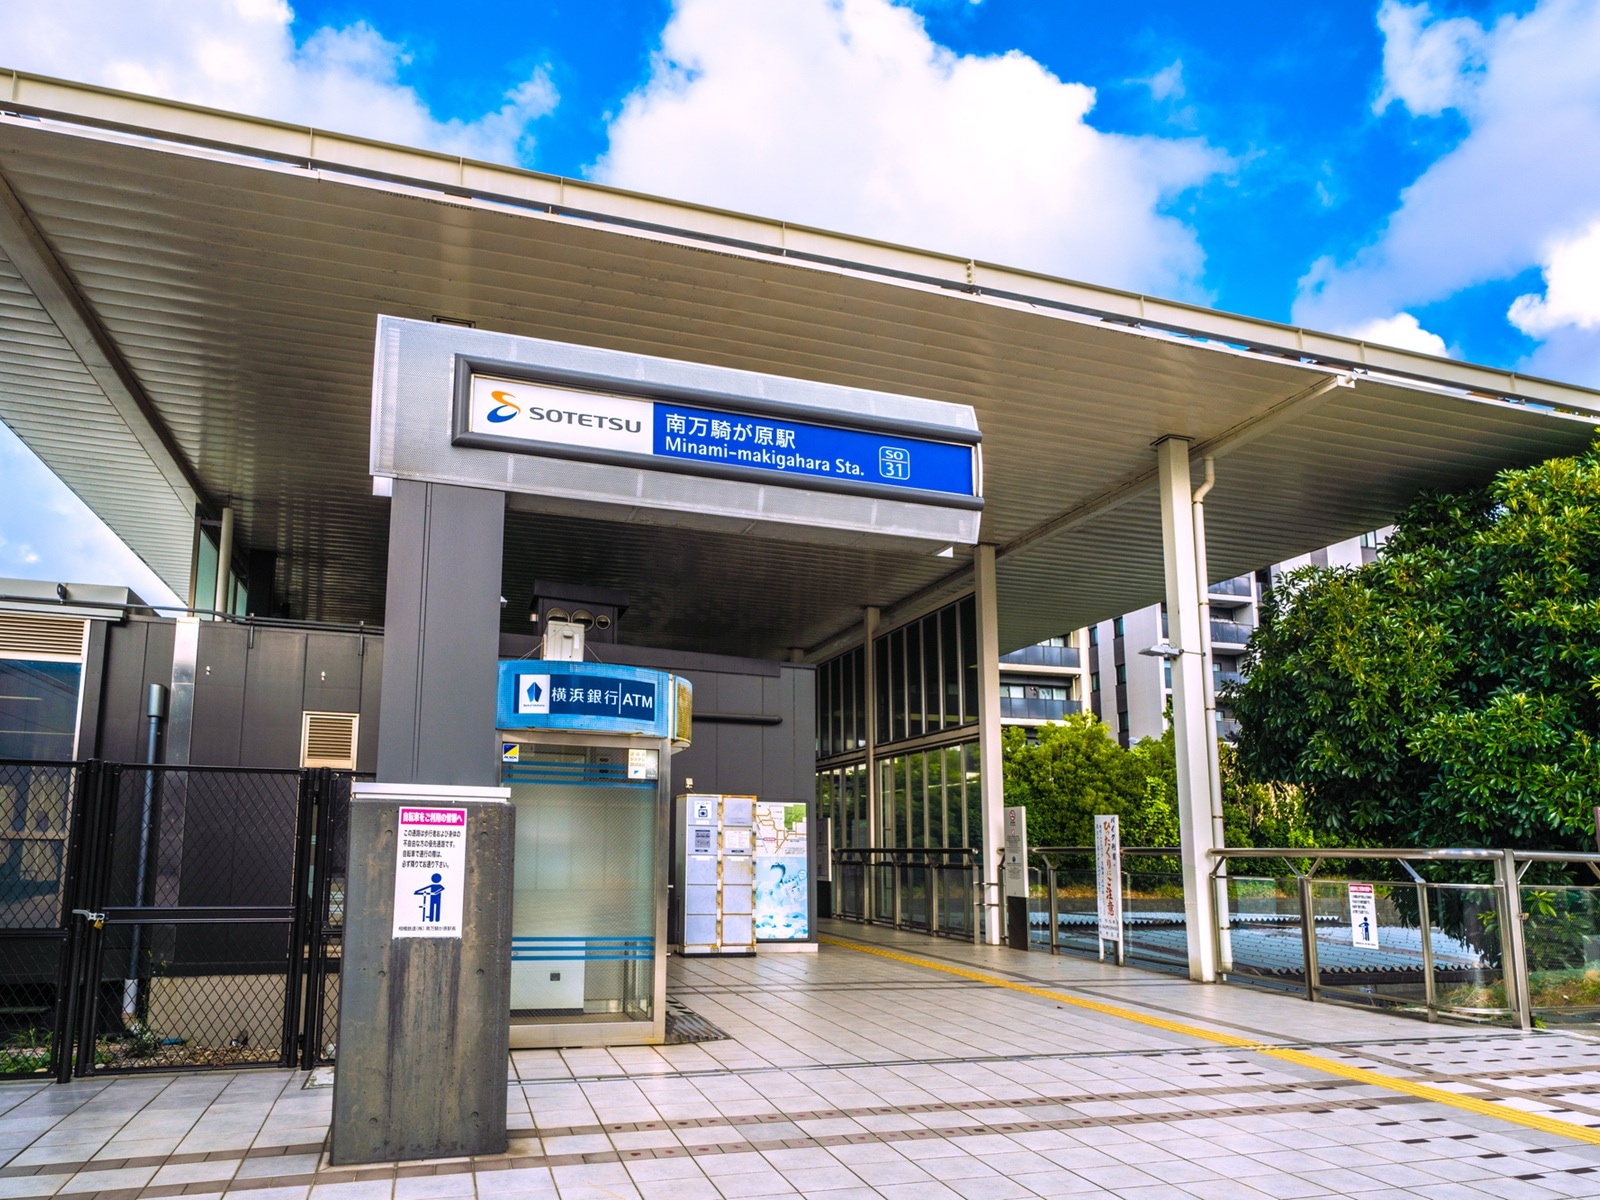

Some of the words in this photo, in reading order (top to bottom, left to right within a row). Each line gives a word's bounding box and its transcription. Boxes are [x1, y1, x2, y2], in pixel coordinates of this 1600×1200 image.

[529, 407, 641, 433] SOTETSU
[665, 413, 796, 449] 南万騎が原駅
[665, 436, 830, 471] Minami-makigahara
[835, 459, 865, 476] Sta.
[885, 450, 904, 460] SO
[885, 462, 903, 477] 31
[551, 687, 618, 705] 横浜銀行
[622, 694, 653, 709] ATM
